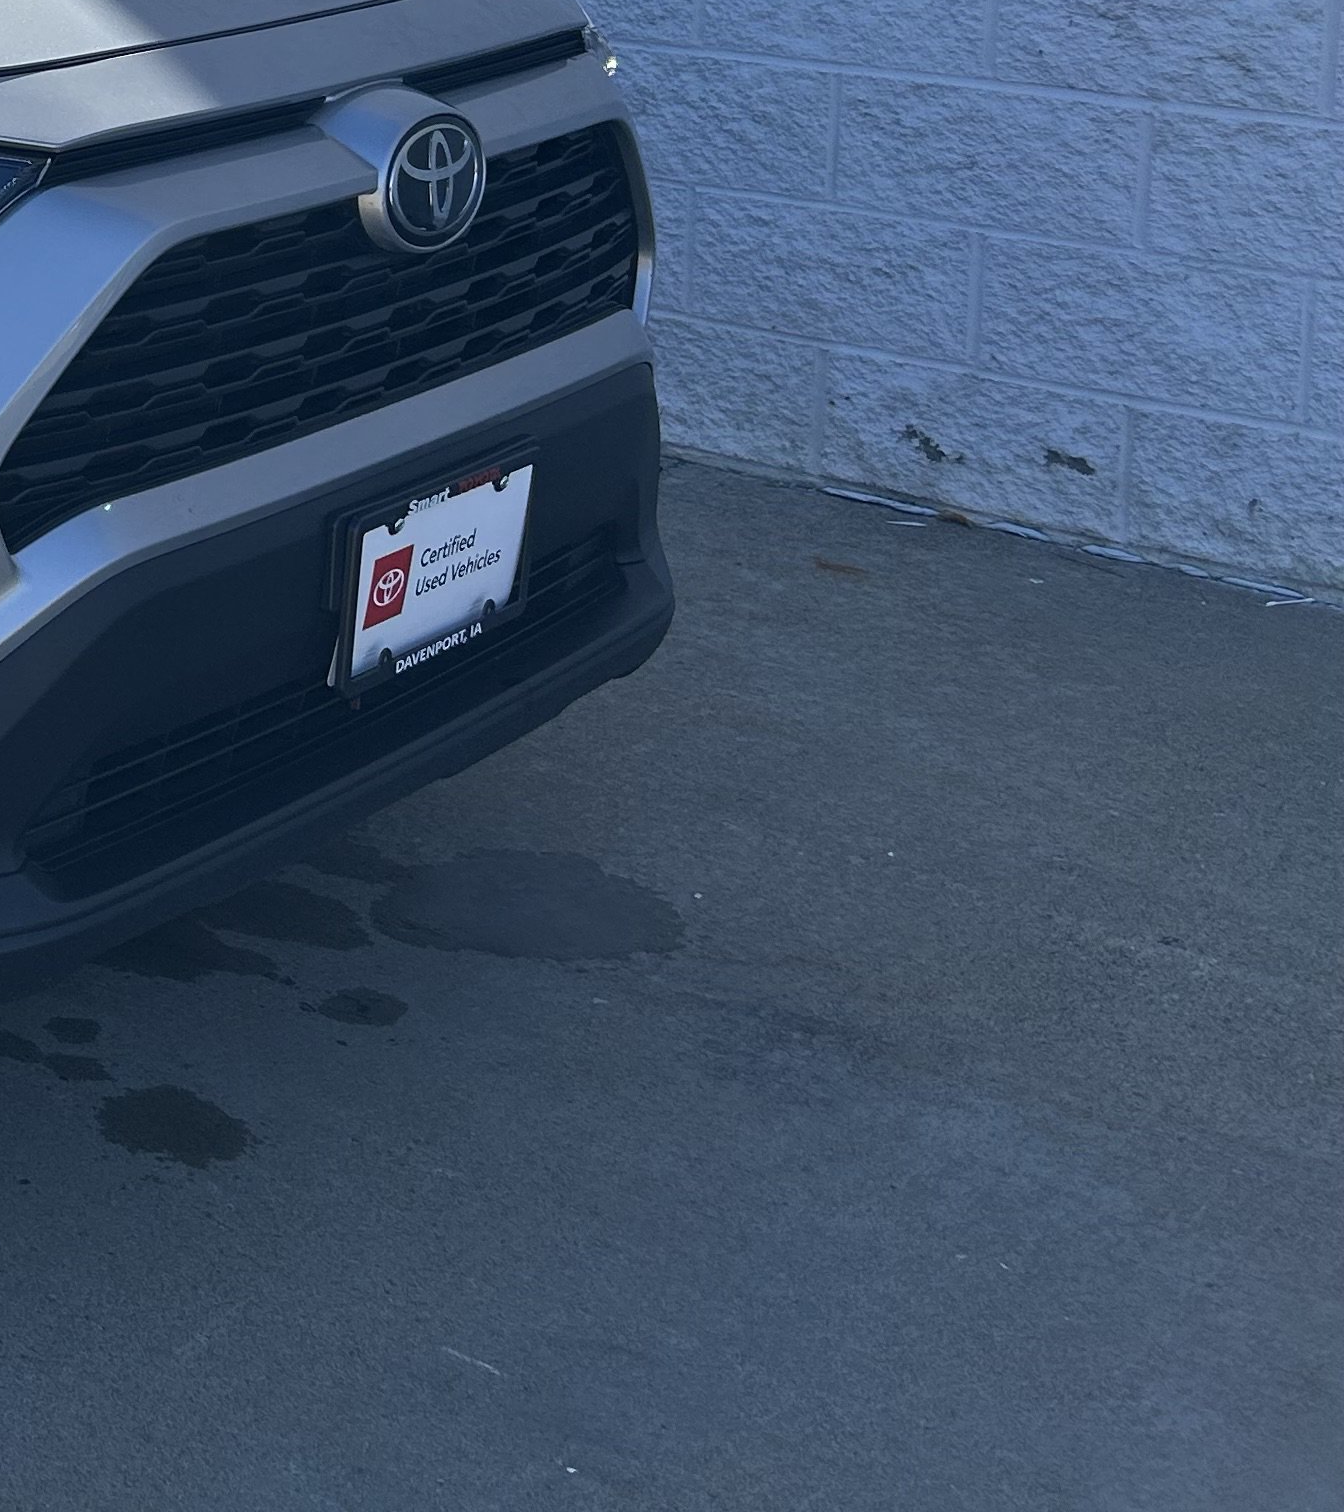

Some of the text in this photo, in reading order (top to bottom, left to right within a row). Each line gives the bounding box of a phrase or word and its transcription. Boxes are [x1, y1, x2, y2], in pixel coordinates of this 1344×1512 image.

[408, 486, 450, 514] Smart
[420, 527, 477, 567] Certified
[415, 548, 502, 596] Used Vehicles
[395, 622, 483, 674] DAVENPORT, IA
